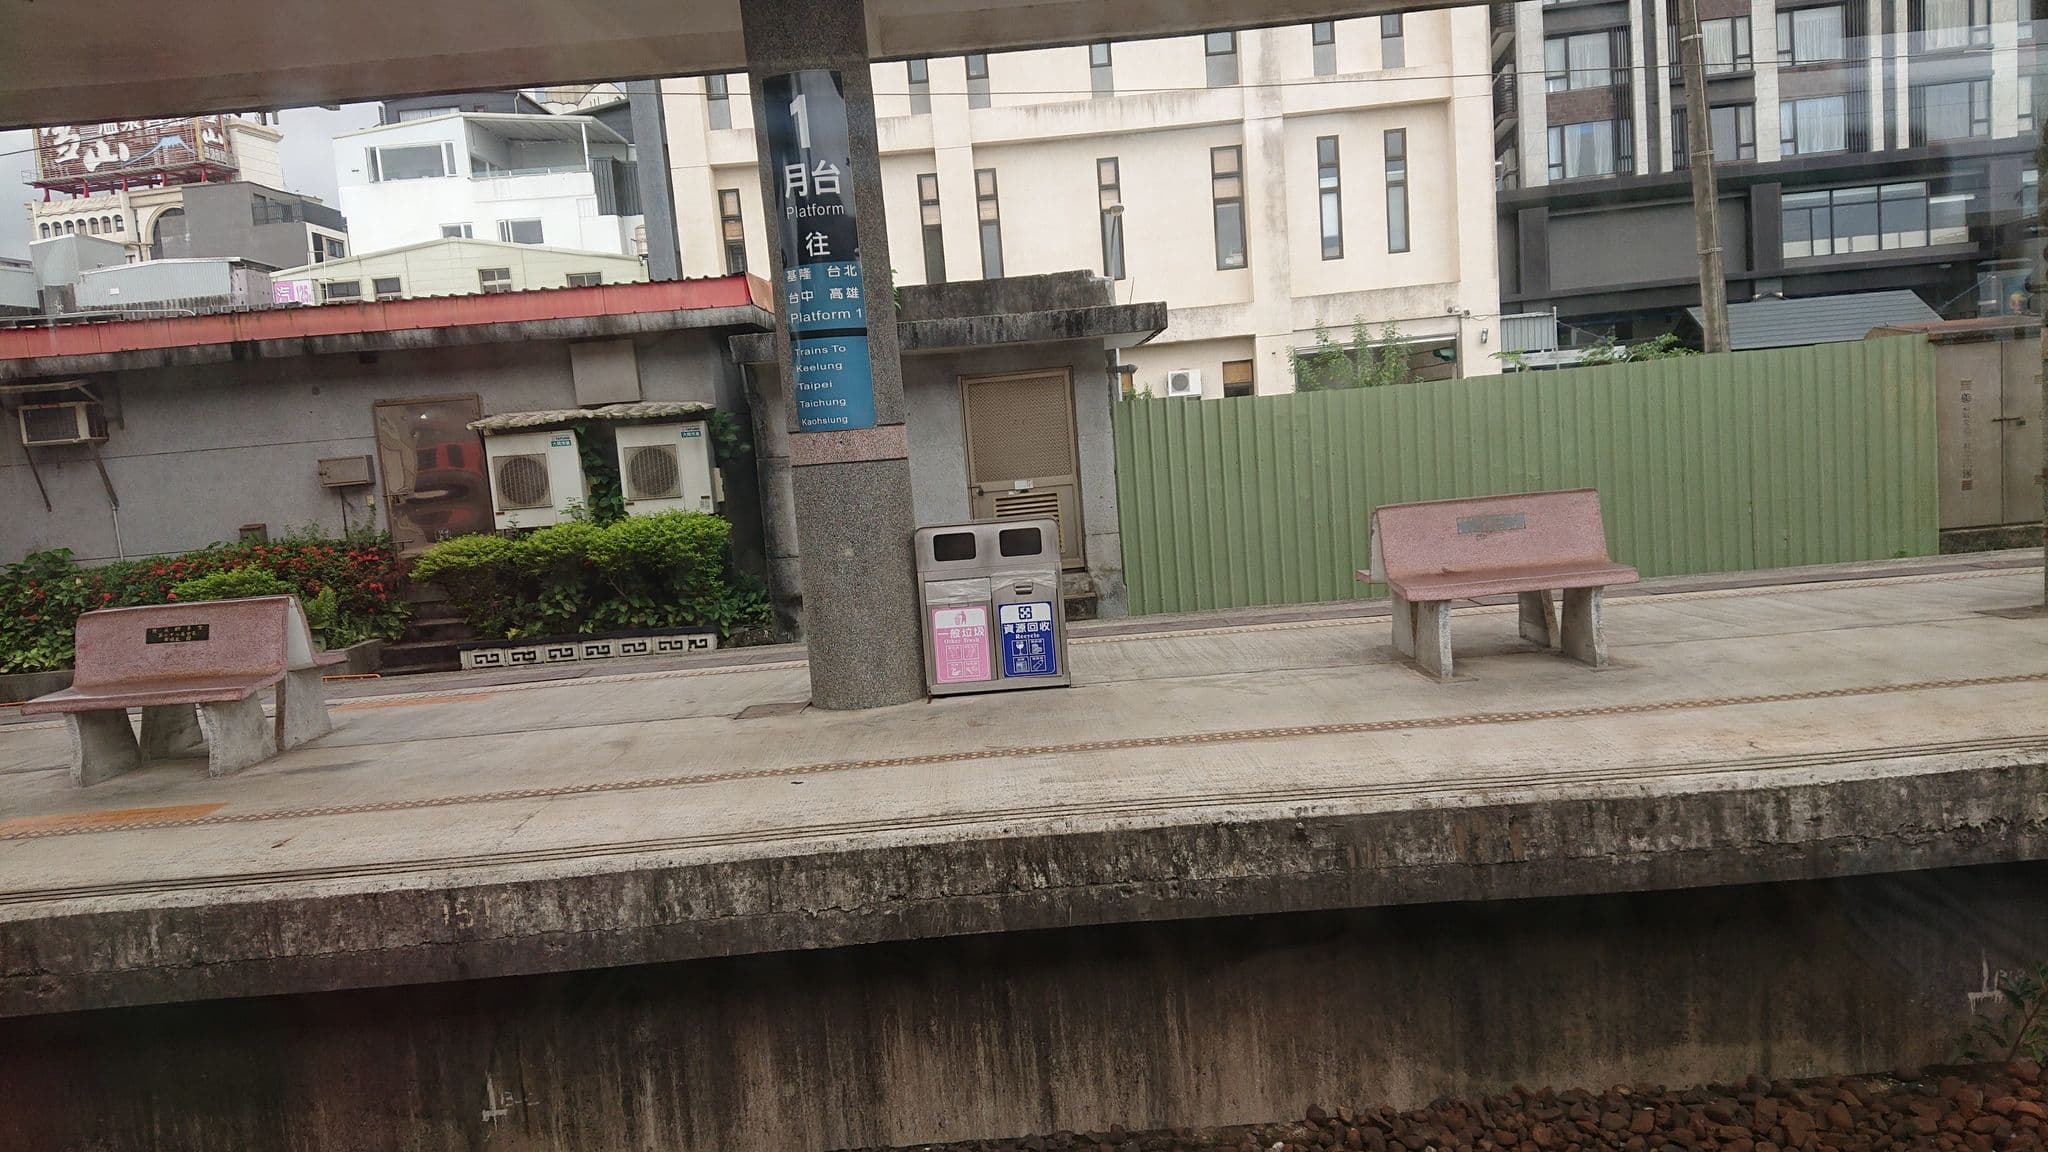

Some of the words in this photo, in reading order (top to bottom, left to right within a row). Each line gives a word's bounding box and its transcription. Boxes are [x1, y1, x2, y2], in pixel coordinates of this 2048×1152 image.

[789, 94, 811, 149] 1
[784, 159, 841, 199] 月台
[786, 203, 845, 219] Platform
[805, 232, 831, 257] 往
[786, 267, 812, 283] 基隆
[827, 264, 858, 278] 台北
[788, 290, 814, 304] 台中
[829, 286, 860, 300] 高雄
[790, 310, 851, 324] Platform
[855, 308, 862, 318] 1
[795, 347, 829, 357] Trains
[831, 344, 846, 353] To
[795, 362, 843, 373] Keelung
[798, 380, 833, 391] Taipei
[800, 398, 847, 409] Taichung
[801, 416, 849, 426] Kaohsiung
[1004, 622, 1050, 633] 資源回收
